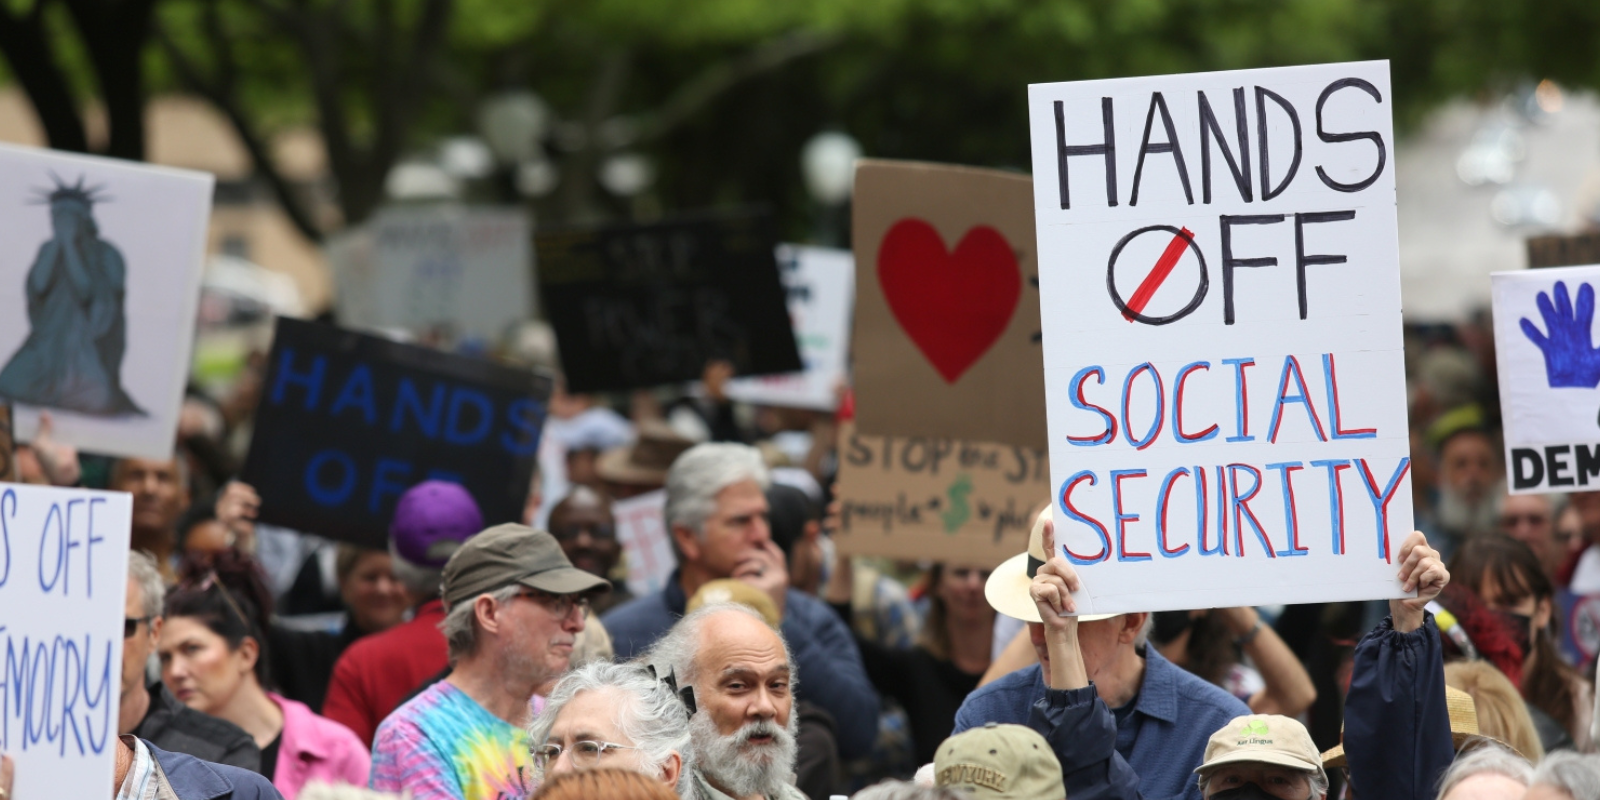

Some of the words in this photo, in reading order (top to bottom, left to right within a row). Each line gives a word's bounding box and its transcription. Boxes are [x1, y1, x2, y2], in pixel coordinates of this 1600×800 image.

[1053, 77, 1386, 209] HANDS
[1106, 210, 1356, 326] OFF
[271, 347, 541, 456] HANDS
[1066, 353, 1377, 450] SOCIAL
[304, 448, 464, 514] OF
[1059, 457, 1411, 565] SECURITY
[38, 497, 106, 597] OFF
[964, 764, 1006, 792] YORK
